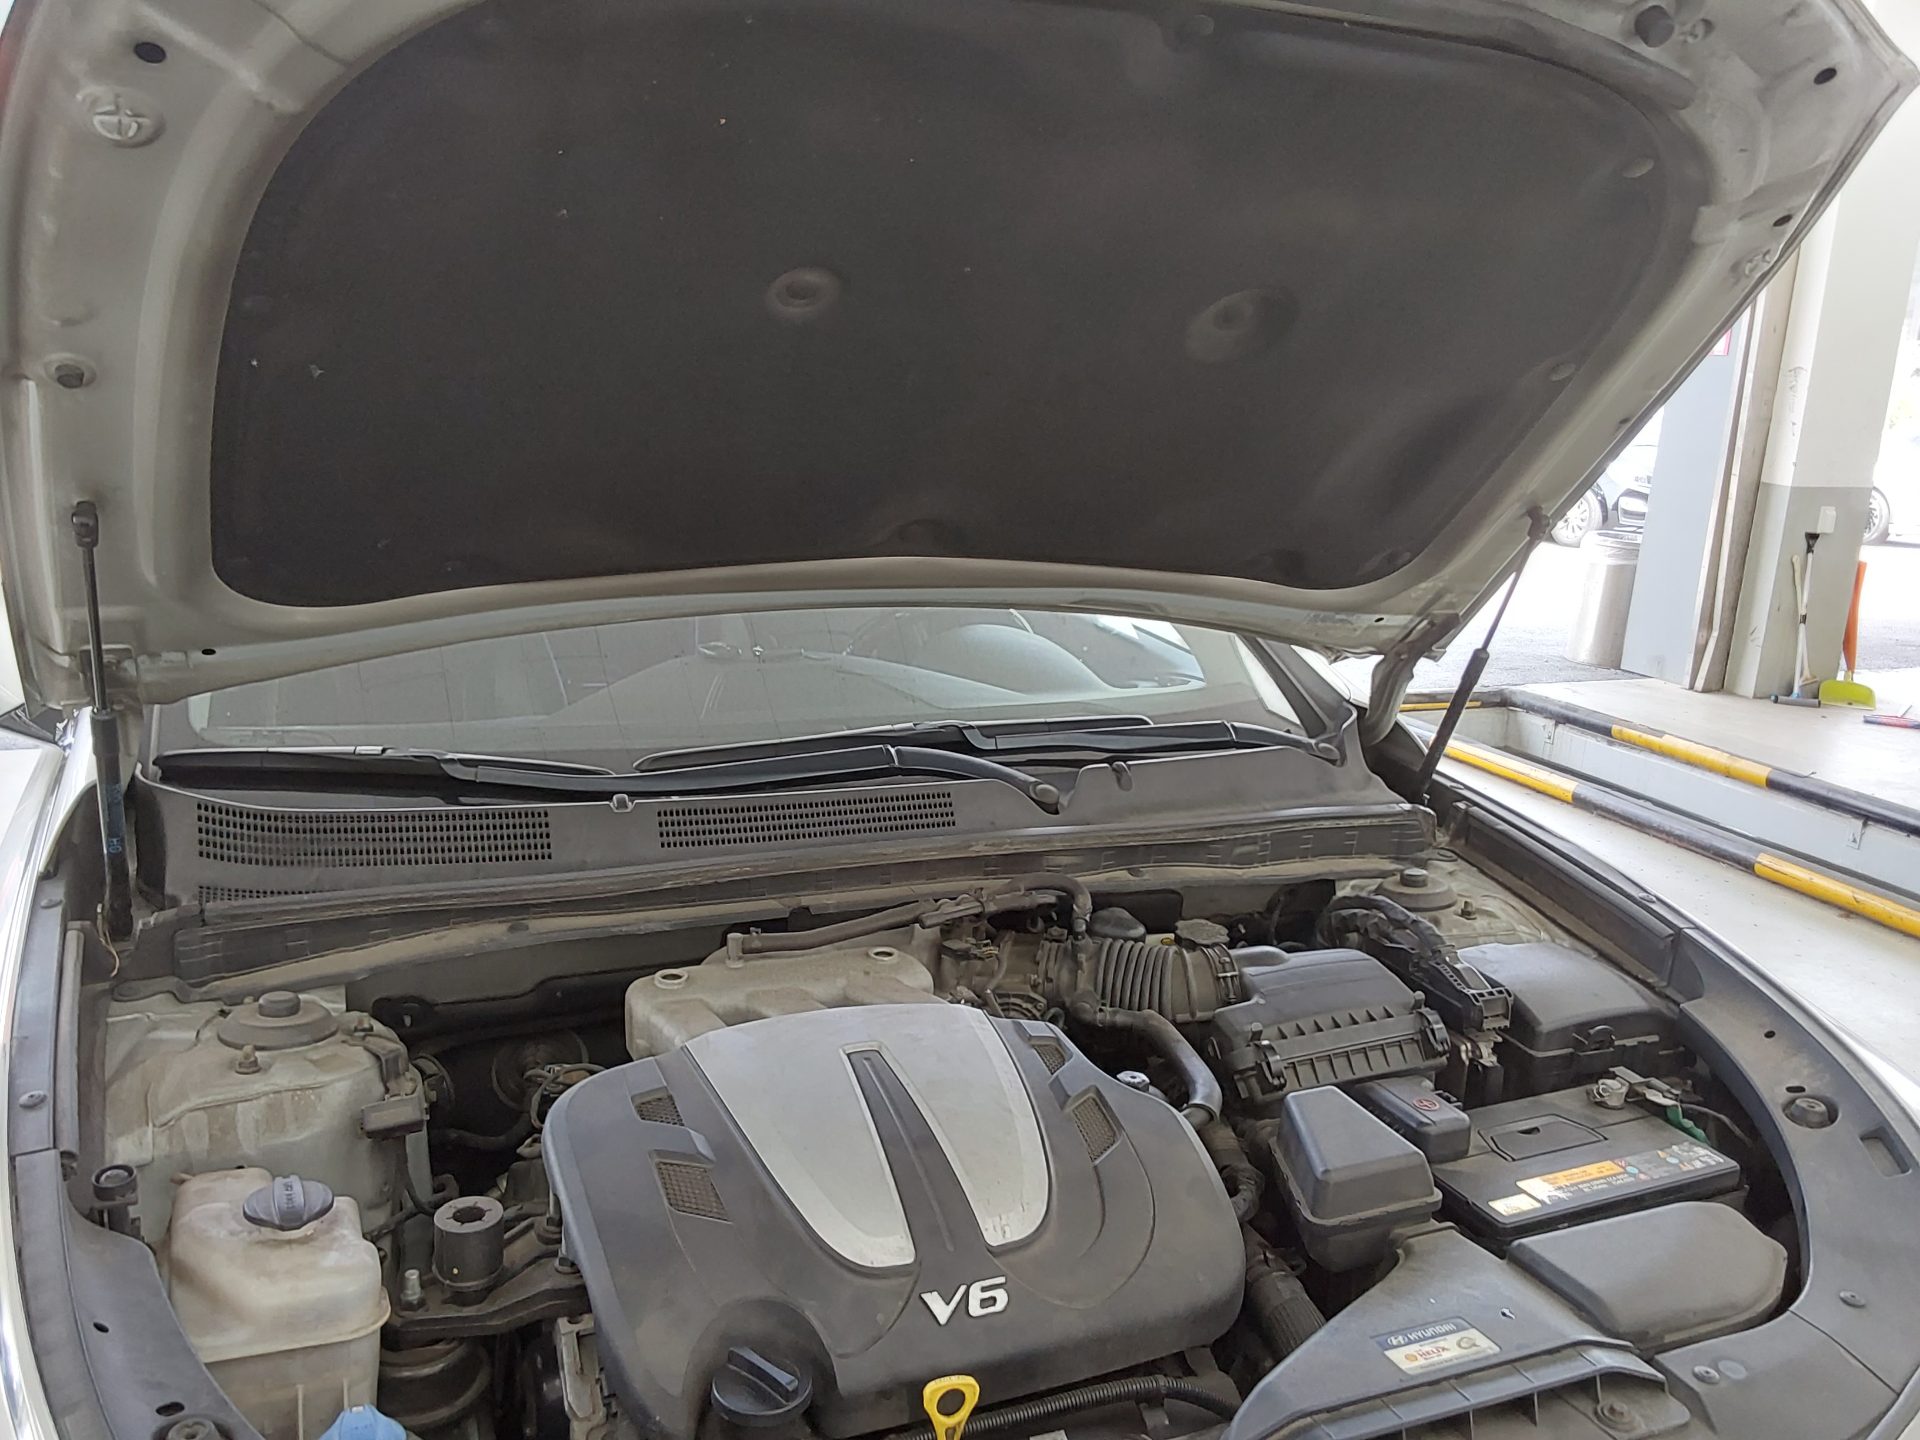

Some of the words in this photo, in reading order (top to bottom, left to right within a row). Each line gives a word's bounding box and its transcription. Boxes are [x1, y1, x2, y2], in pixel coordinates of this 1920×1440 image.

[920, 1276, 1009, 1326] V6
[1407, 1322, 1457, 1341] HYUNDAI
[1417, 1346, 1449, 1358] HELIX
